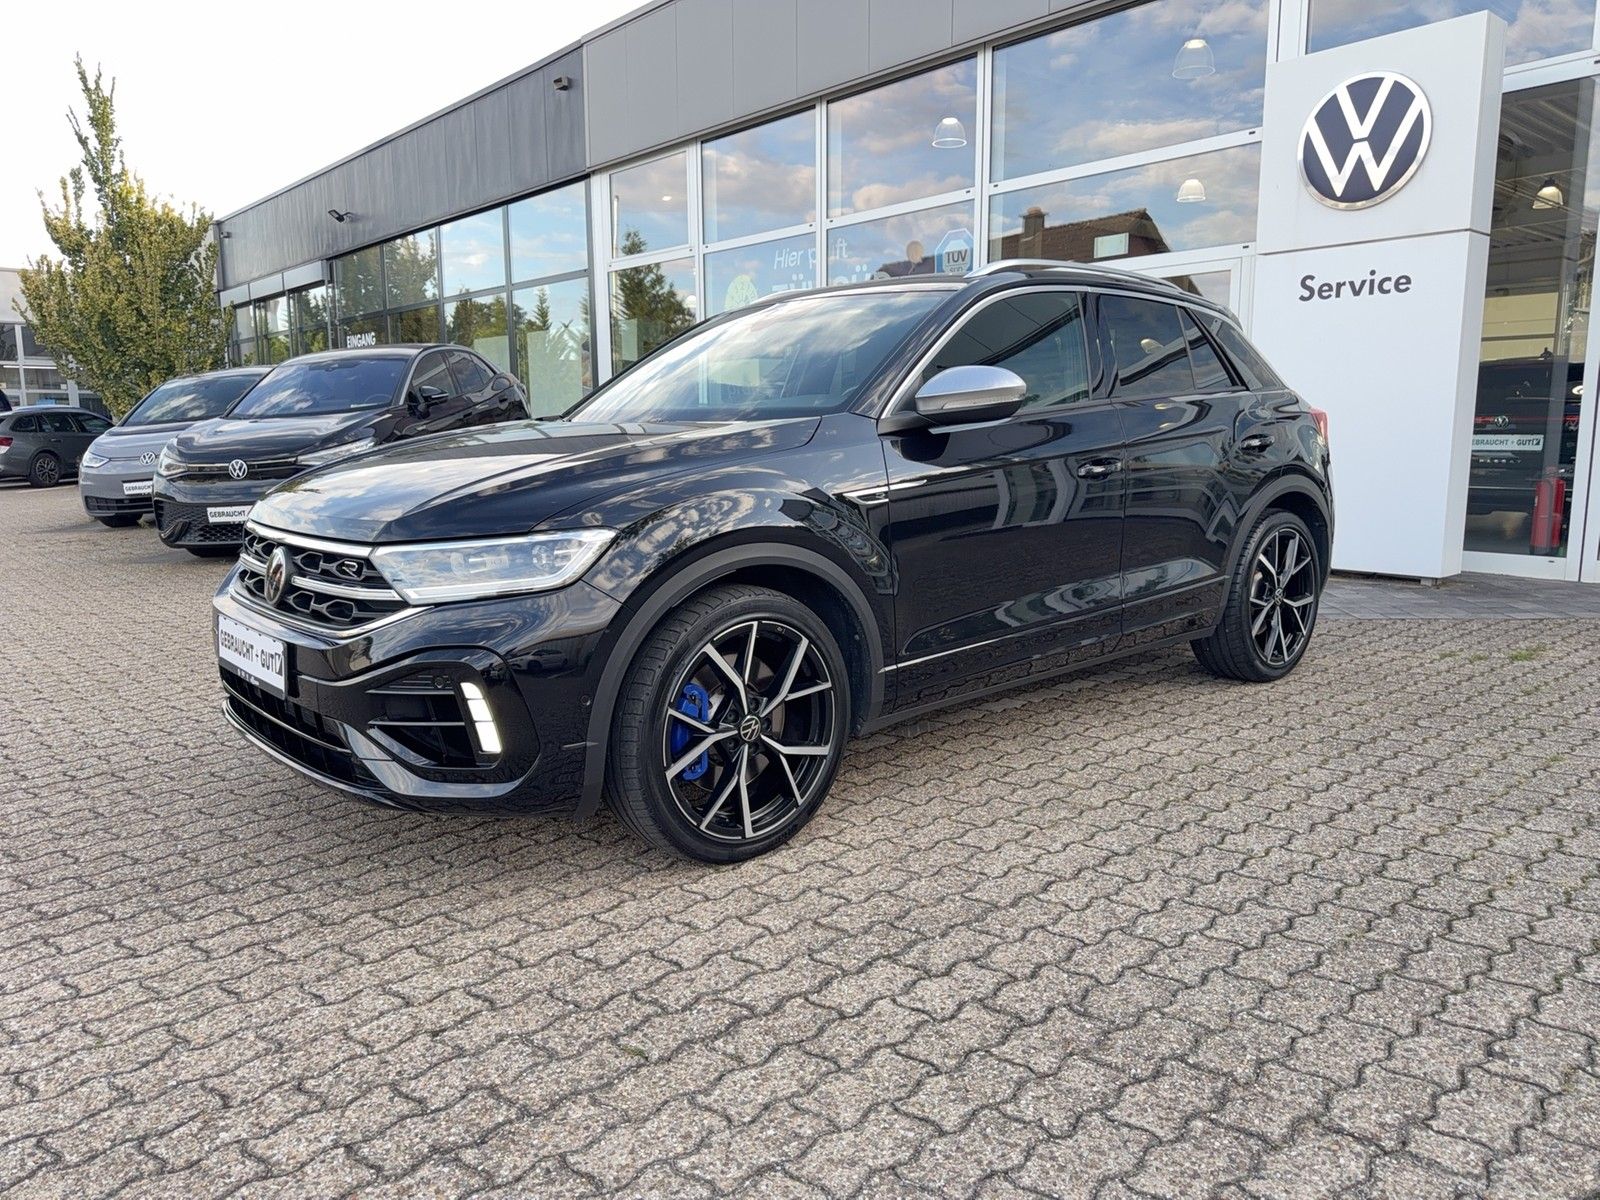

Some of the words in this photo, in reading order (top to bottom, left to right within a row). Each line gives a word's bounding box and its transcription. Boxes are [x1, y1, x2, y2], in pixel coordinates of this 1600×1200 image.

[773, 247, 806, 270] Hier
[944, 248, 968, 264] TÜV
[1298, 269, 1412, 302] Service
[346, 331, 376, 349] EINGANG
[208, 510, 246, 518] GEBRAUCHT
[220, 629, 254, 662] GEBRAUCHT
